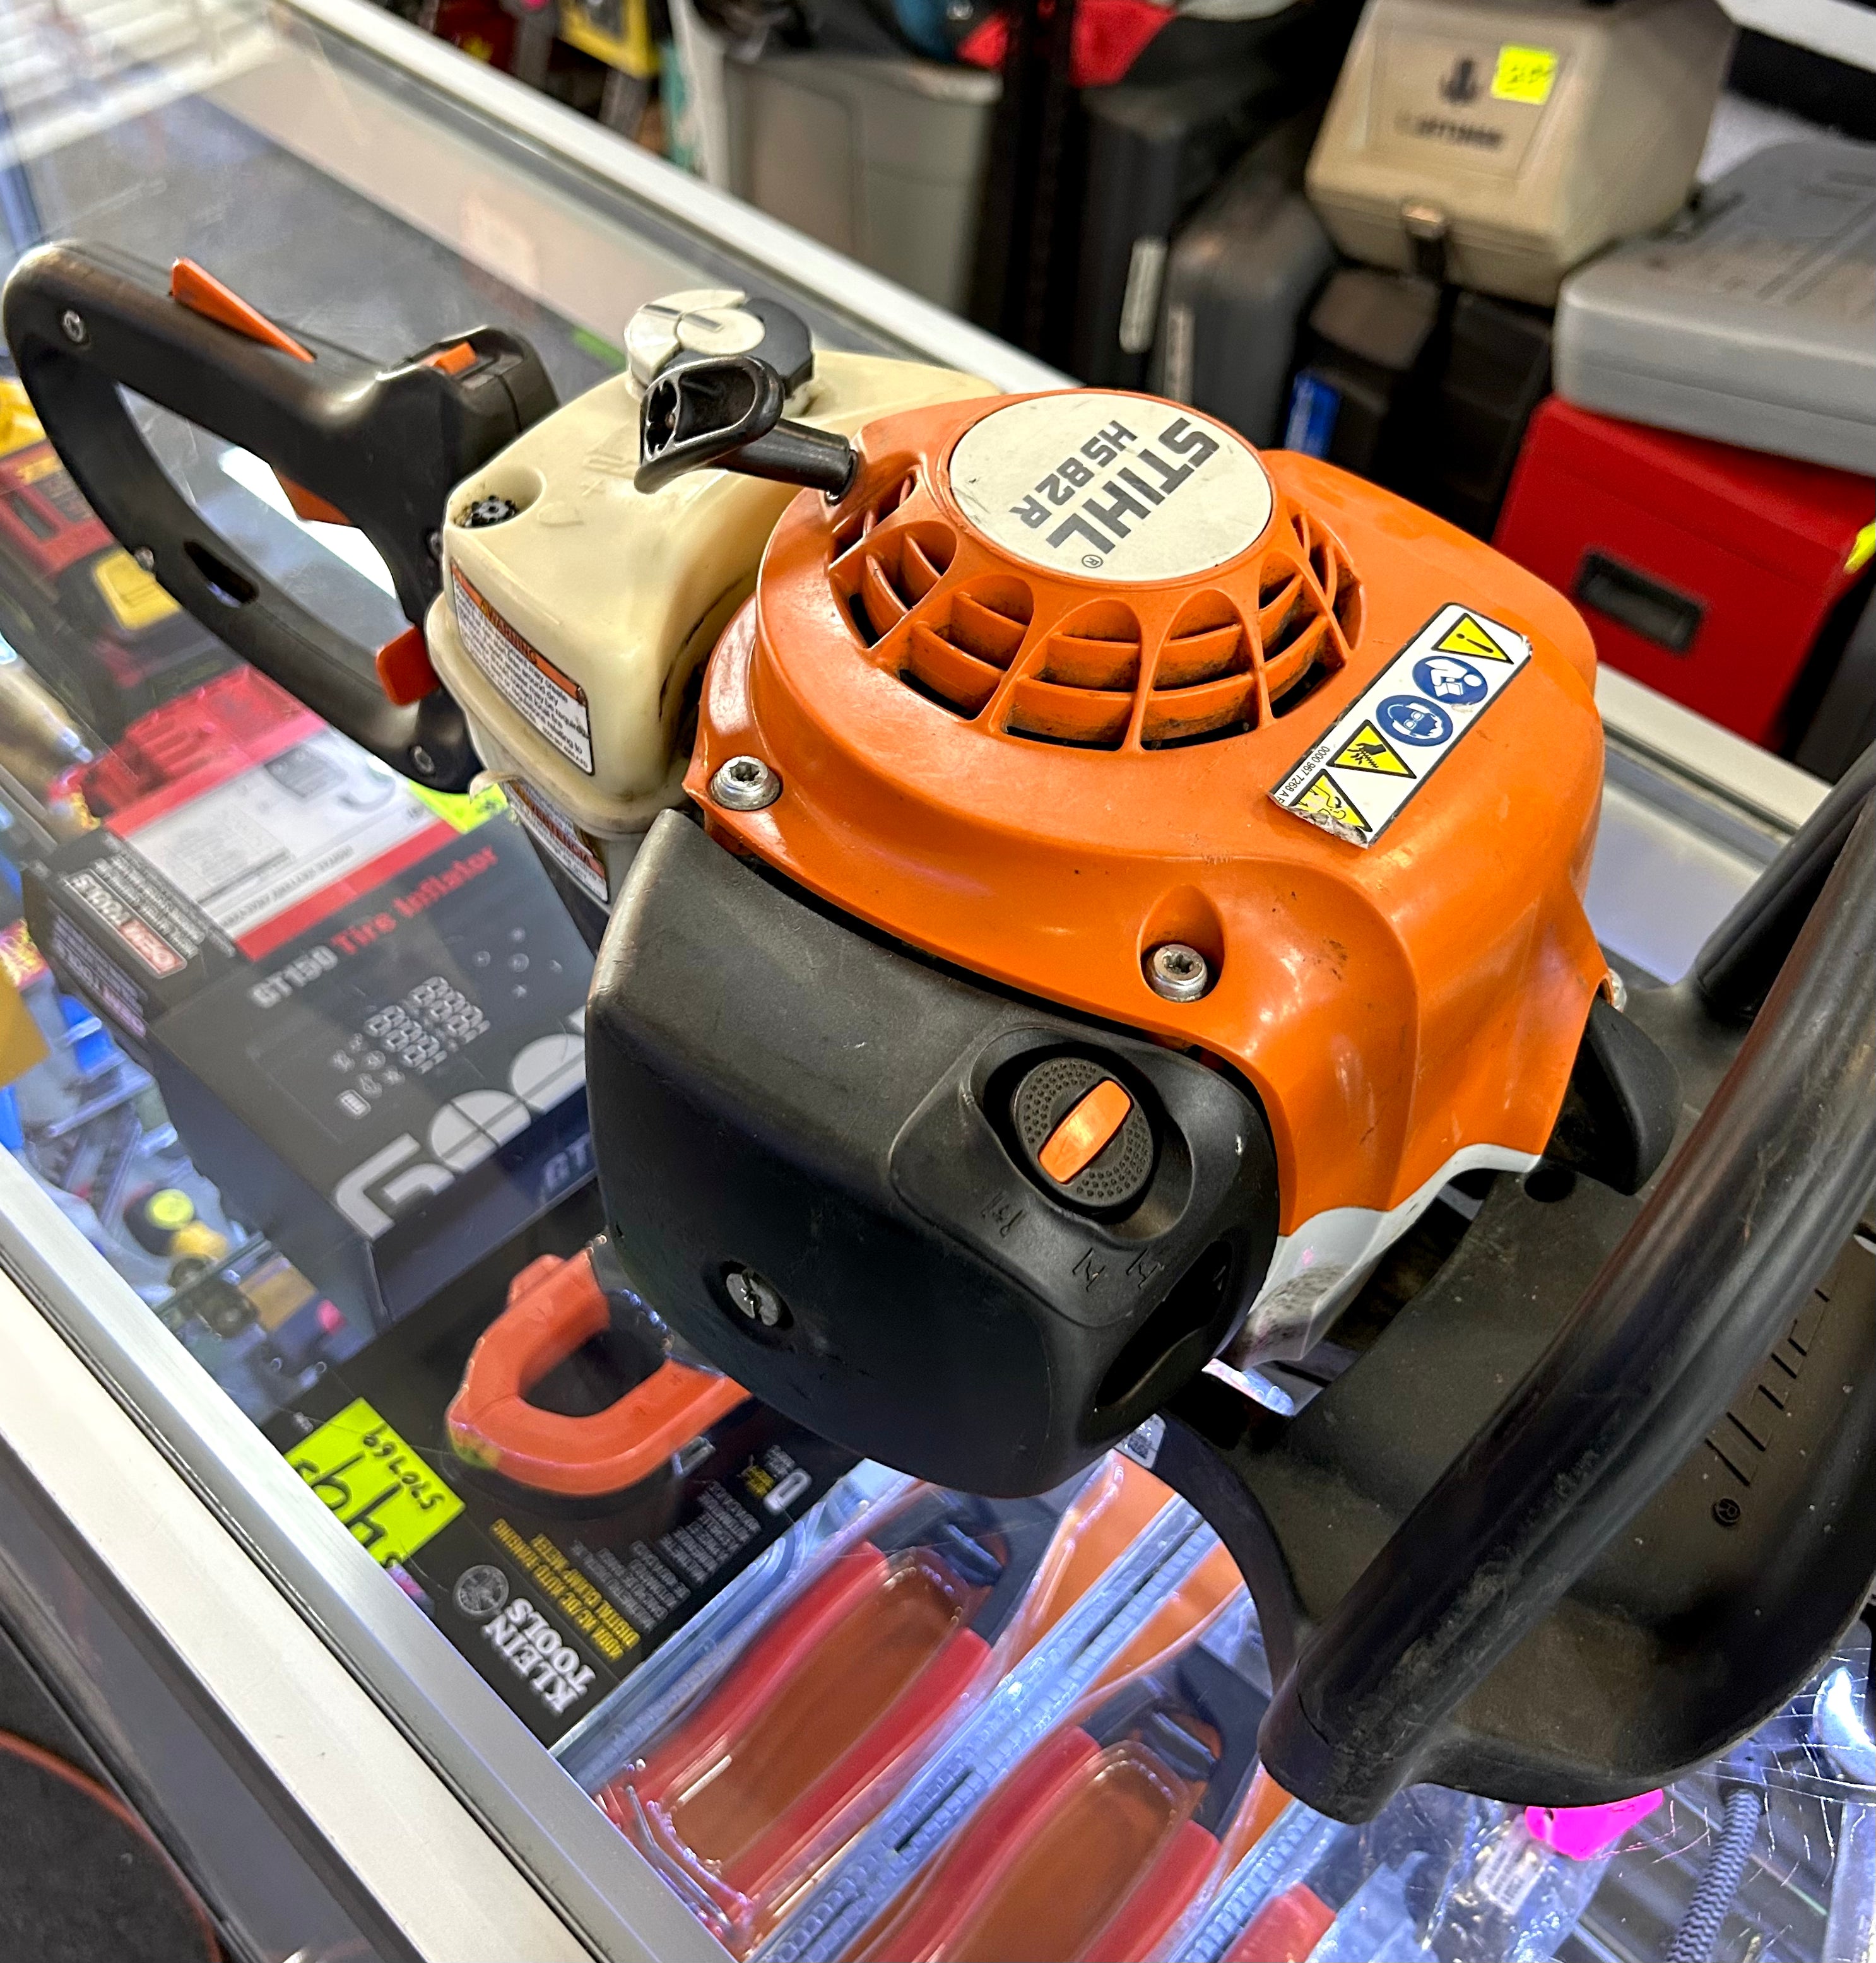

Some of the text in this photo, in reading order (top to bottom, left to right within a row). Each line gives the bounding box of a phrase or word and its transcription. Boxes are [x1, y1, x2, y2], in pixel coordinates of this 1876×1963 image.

[1046, 418, 1219, 555] STIHL
[1285, 774, 1305, 792] 7268
[1301, 762, 1316, 776] 967
[1311, 746, 1330, 763] 0000
[251, 946, 338, 1008] GT150
[330, 912, 396, 955] Tire
[393, 846, 498, 918] Inflator
[506, 1598, 596, 1695] TOOLS
[596, 1599, 640, 1649] DIGITAL
[481, 1615, 579, 1713] KLEIN
